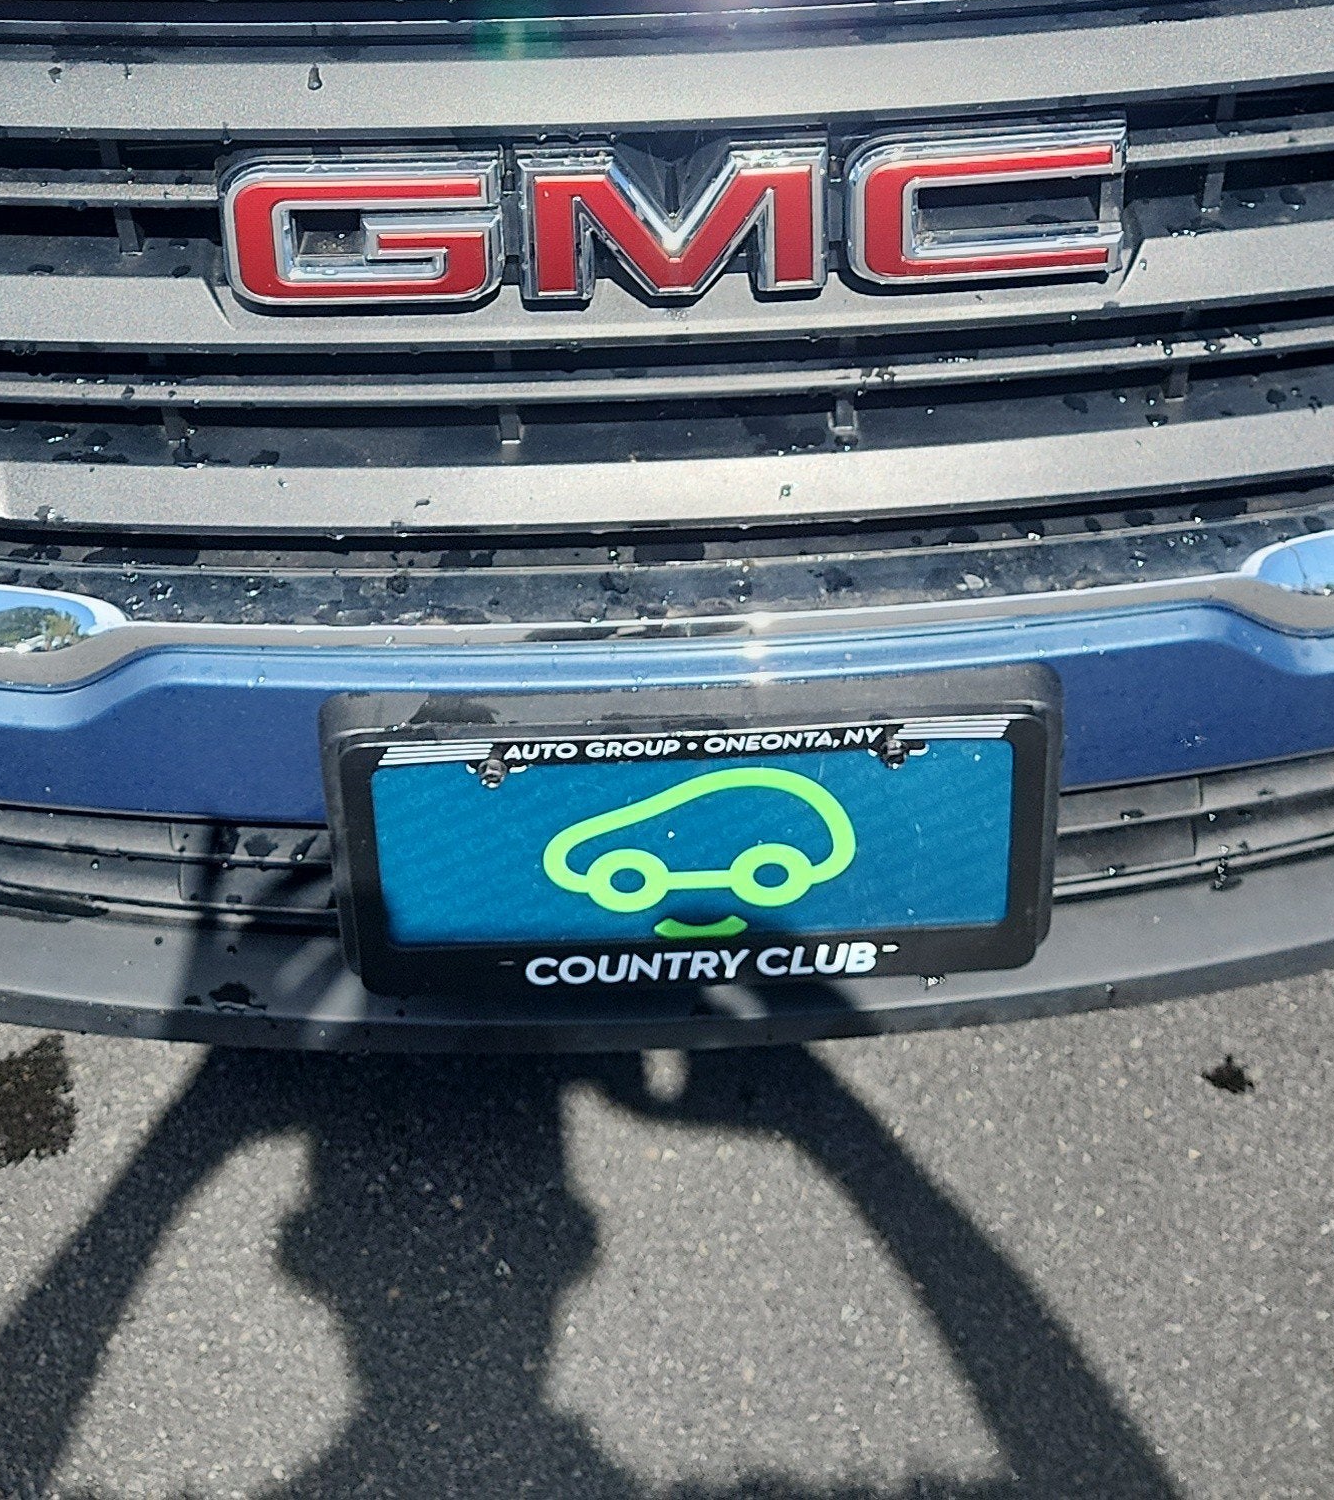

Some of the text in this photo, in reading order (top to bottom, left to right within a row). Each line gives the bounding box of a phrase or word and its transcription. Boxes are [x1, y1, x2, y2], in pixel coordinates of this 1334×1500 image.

[222, 119, 1127, 306] GMC
[503, 742, 578, 761] AUTO
[584, 739, 681, 759] GROUP
[524, 941, 878, 986] COUNTRY CLUB
